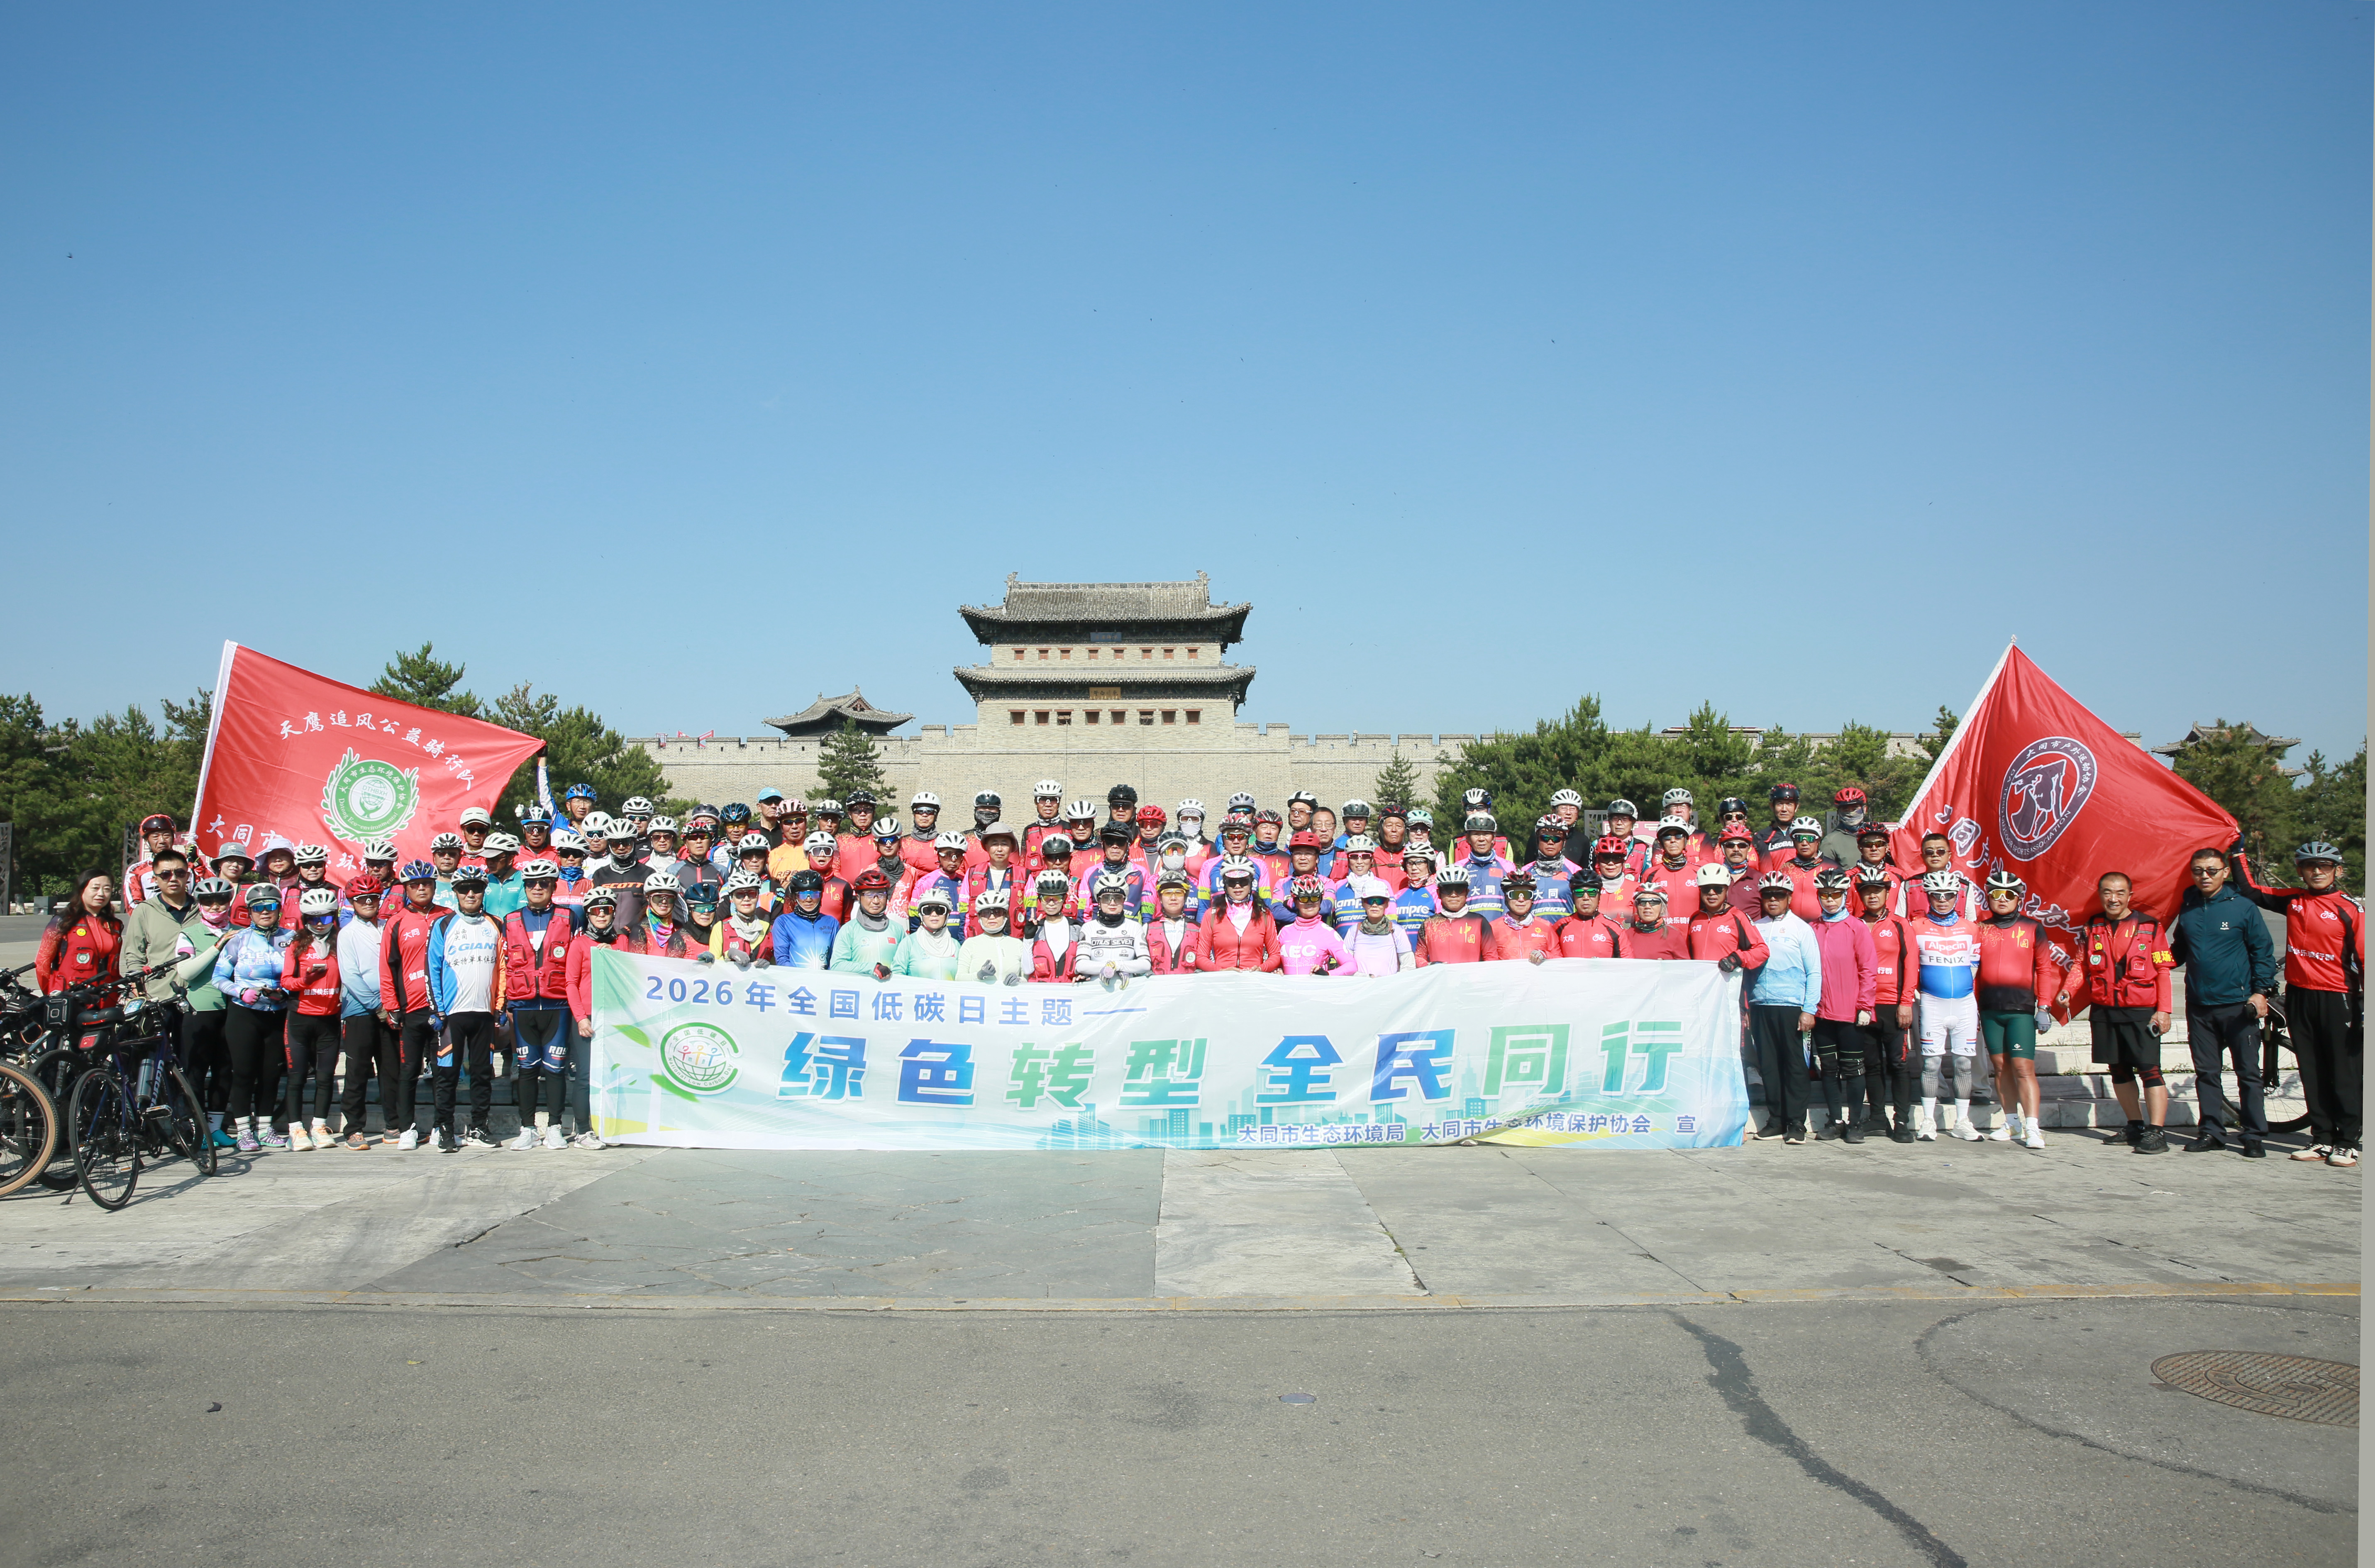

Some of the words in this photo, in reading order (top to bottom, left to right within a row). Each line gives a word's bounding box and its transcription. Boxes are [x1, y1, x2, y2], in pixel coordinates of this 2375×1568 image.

[2026, 740, 2092, 797] 大同市户外运动协会
[339, 764, 407, 809] 大同市生态环境保护协会
[362, 785, 388, 796] DTHBXH
[339, 798, 349, 819] Datong
[347, 811, 398, 830] Eco-environmental
[1471, 885, 1496, 896] 大同
[1533, 888, 1558, 899] 大同
[1334, 899, 1364, 909] lamp
[403, 928, 420, 941] 大同
[1691, 925, 1702, 933] 大同
[1562, 934, 1574, 943] 大同
[458, 943, 497, 952] GIANT
[1928, 941, 1965, 951] Alpecin
[1928, 955, 1965, 964] FENIX
[2151, 950, 2175, 964] 现场
[1877, 967, 1893, 975] 行群
[672, 1028, 727, 1046] 全国低碳日
[776, 1030, 1209, 1111] 绿色转型
[1253, 1020, 1684, 1107] 全民同行
[668, 1057, 687, 1080] National
[703, 1075, 725, 1087] Carbon
[725, 1063, 734, 1076] Day
[1238, 1124, 1405, 1144] 大同市生态环境局
[1421, 1113, 1651, 1140] 大同市生态环境保护协会
[1676, 1115, 1696, 1134] 宣
